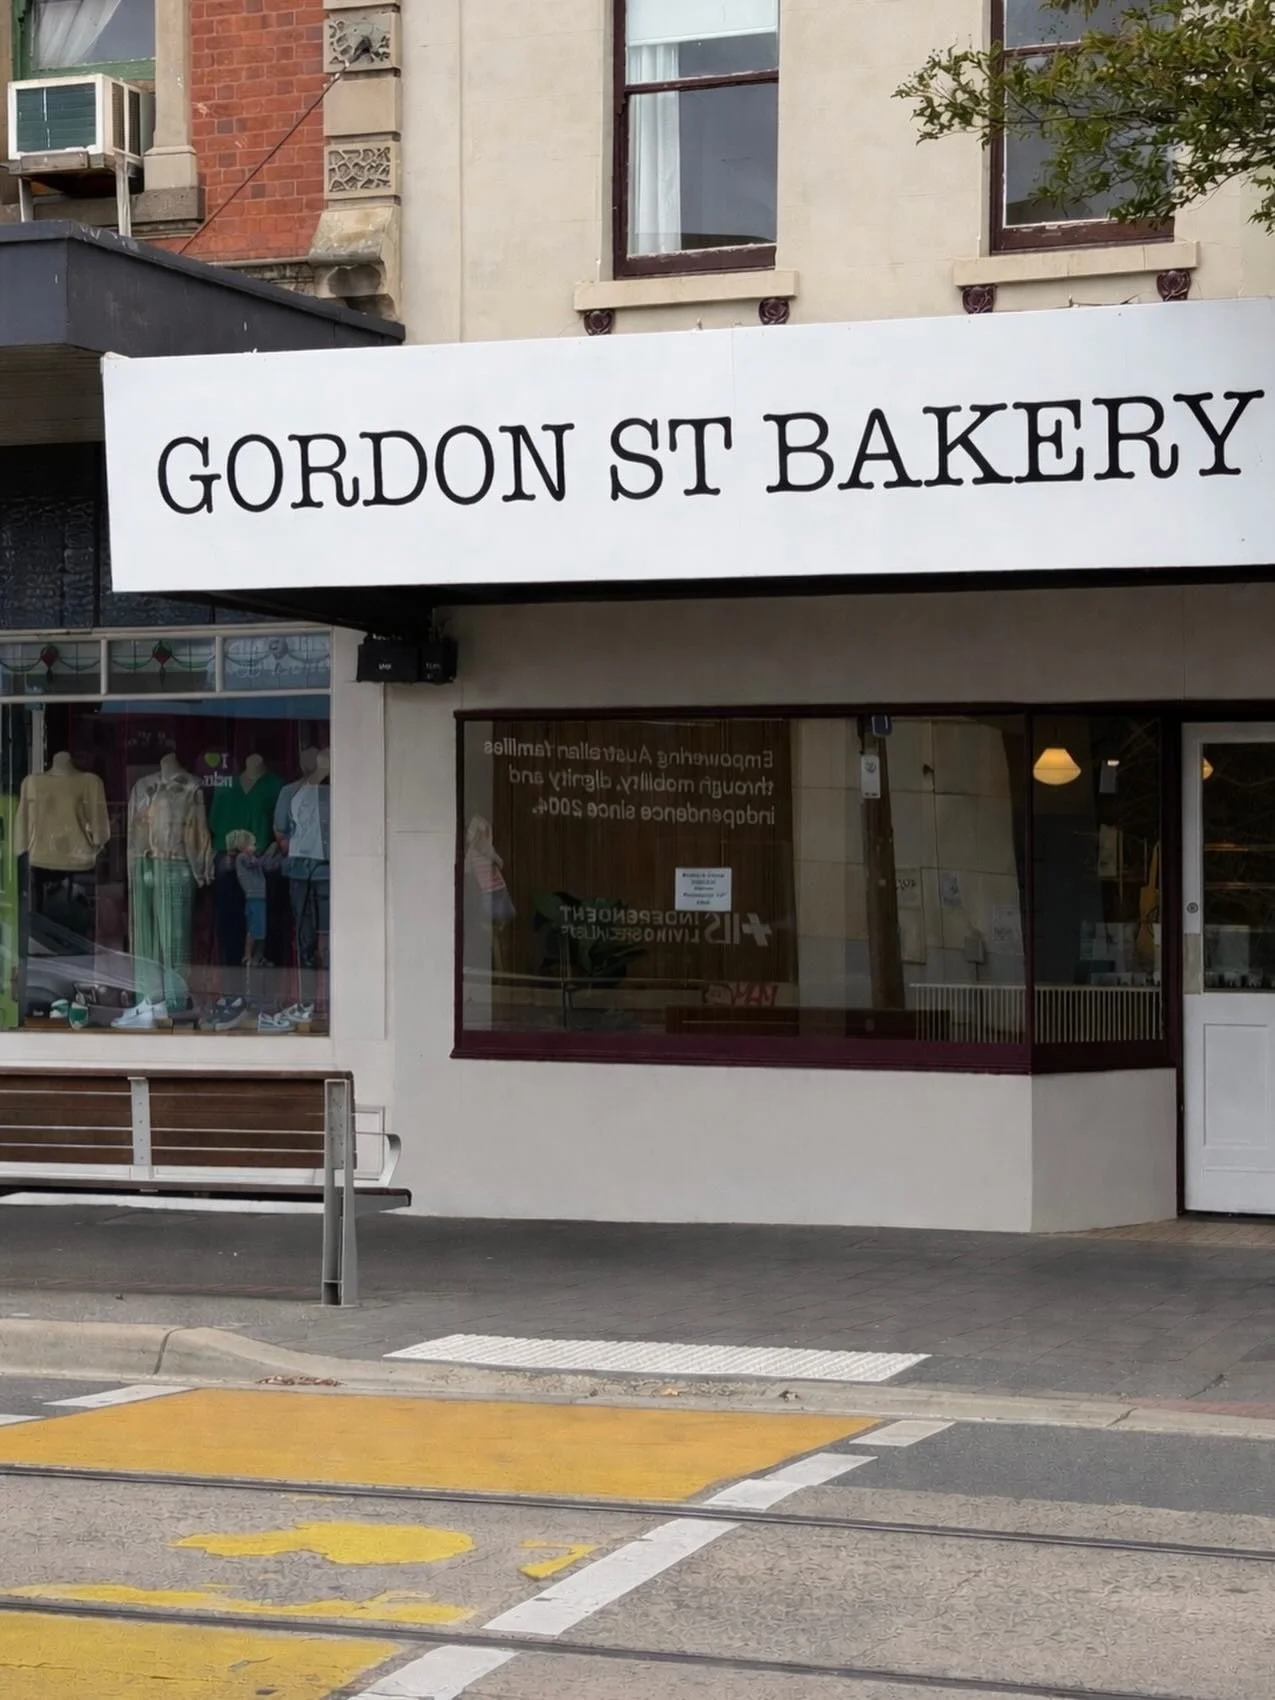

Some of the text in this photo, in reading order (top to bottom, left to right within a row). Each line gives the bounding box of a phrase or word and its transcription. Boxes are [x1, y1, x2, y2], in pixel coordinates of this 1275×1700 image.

[158, 390, 1264, 514] GORDON ST BAKERY
